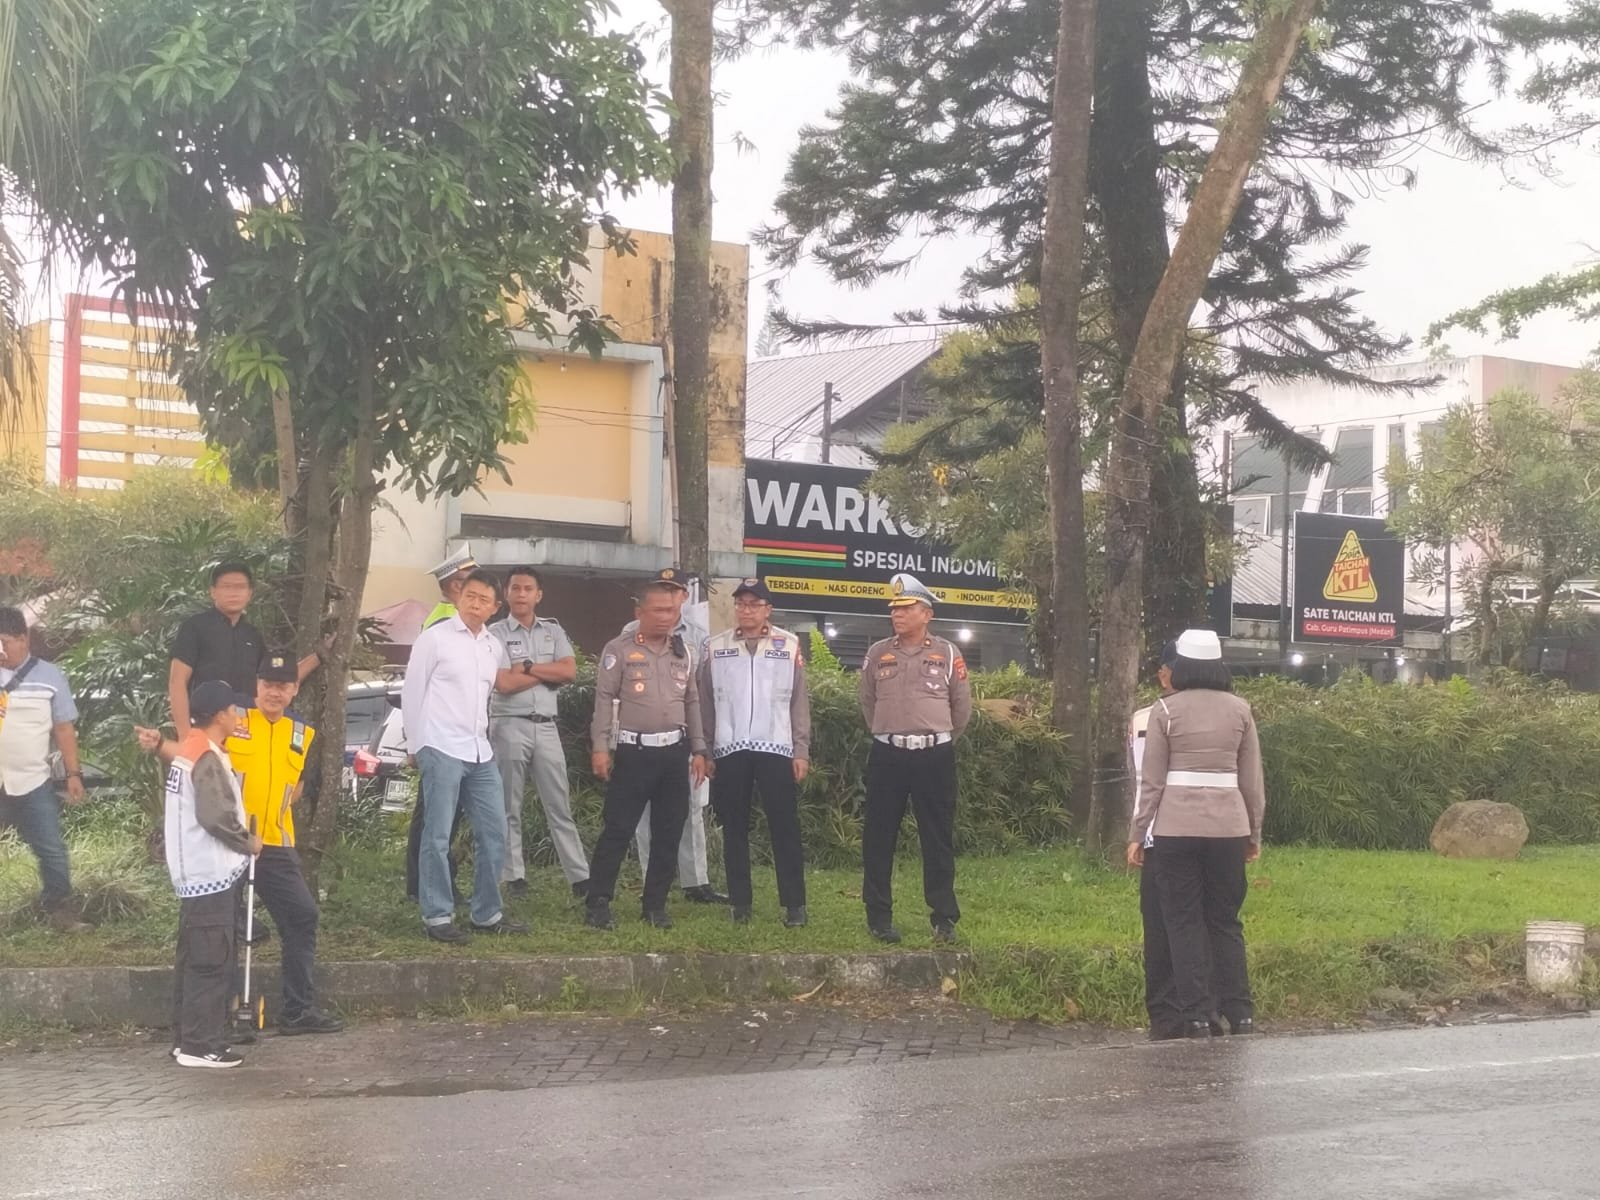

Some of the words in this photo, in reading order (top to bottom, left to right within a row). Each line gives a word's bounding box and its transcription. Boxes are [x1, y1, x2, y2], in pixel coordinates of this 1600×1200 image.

[853, 549, 926, 573] SPESIAL
[1333, 557, 1369, 572] TAICHAN
[1334, 568, 1369, 593] KTL
[768, 580, 809, 590] TERSEDIA
[828, 585, 847, 593] NASI
[850, 586, 885, 596] GORENG
[960, 593, 995, 602] INDOMIE
[1303, 607, 1329, 619] SATE
[1332, 609, 1376, 622] TAICHAN
[1378, 612, 1396, 624] KTL
[1321, 624, 1337, 632] Guru
